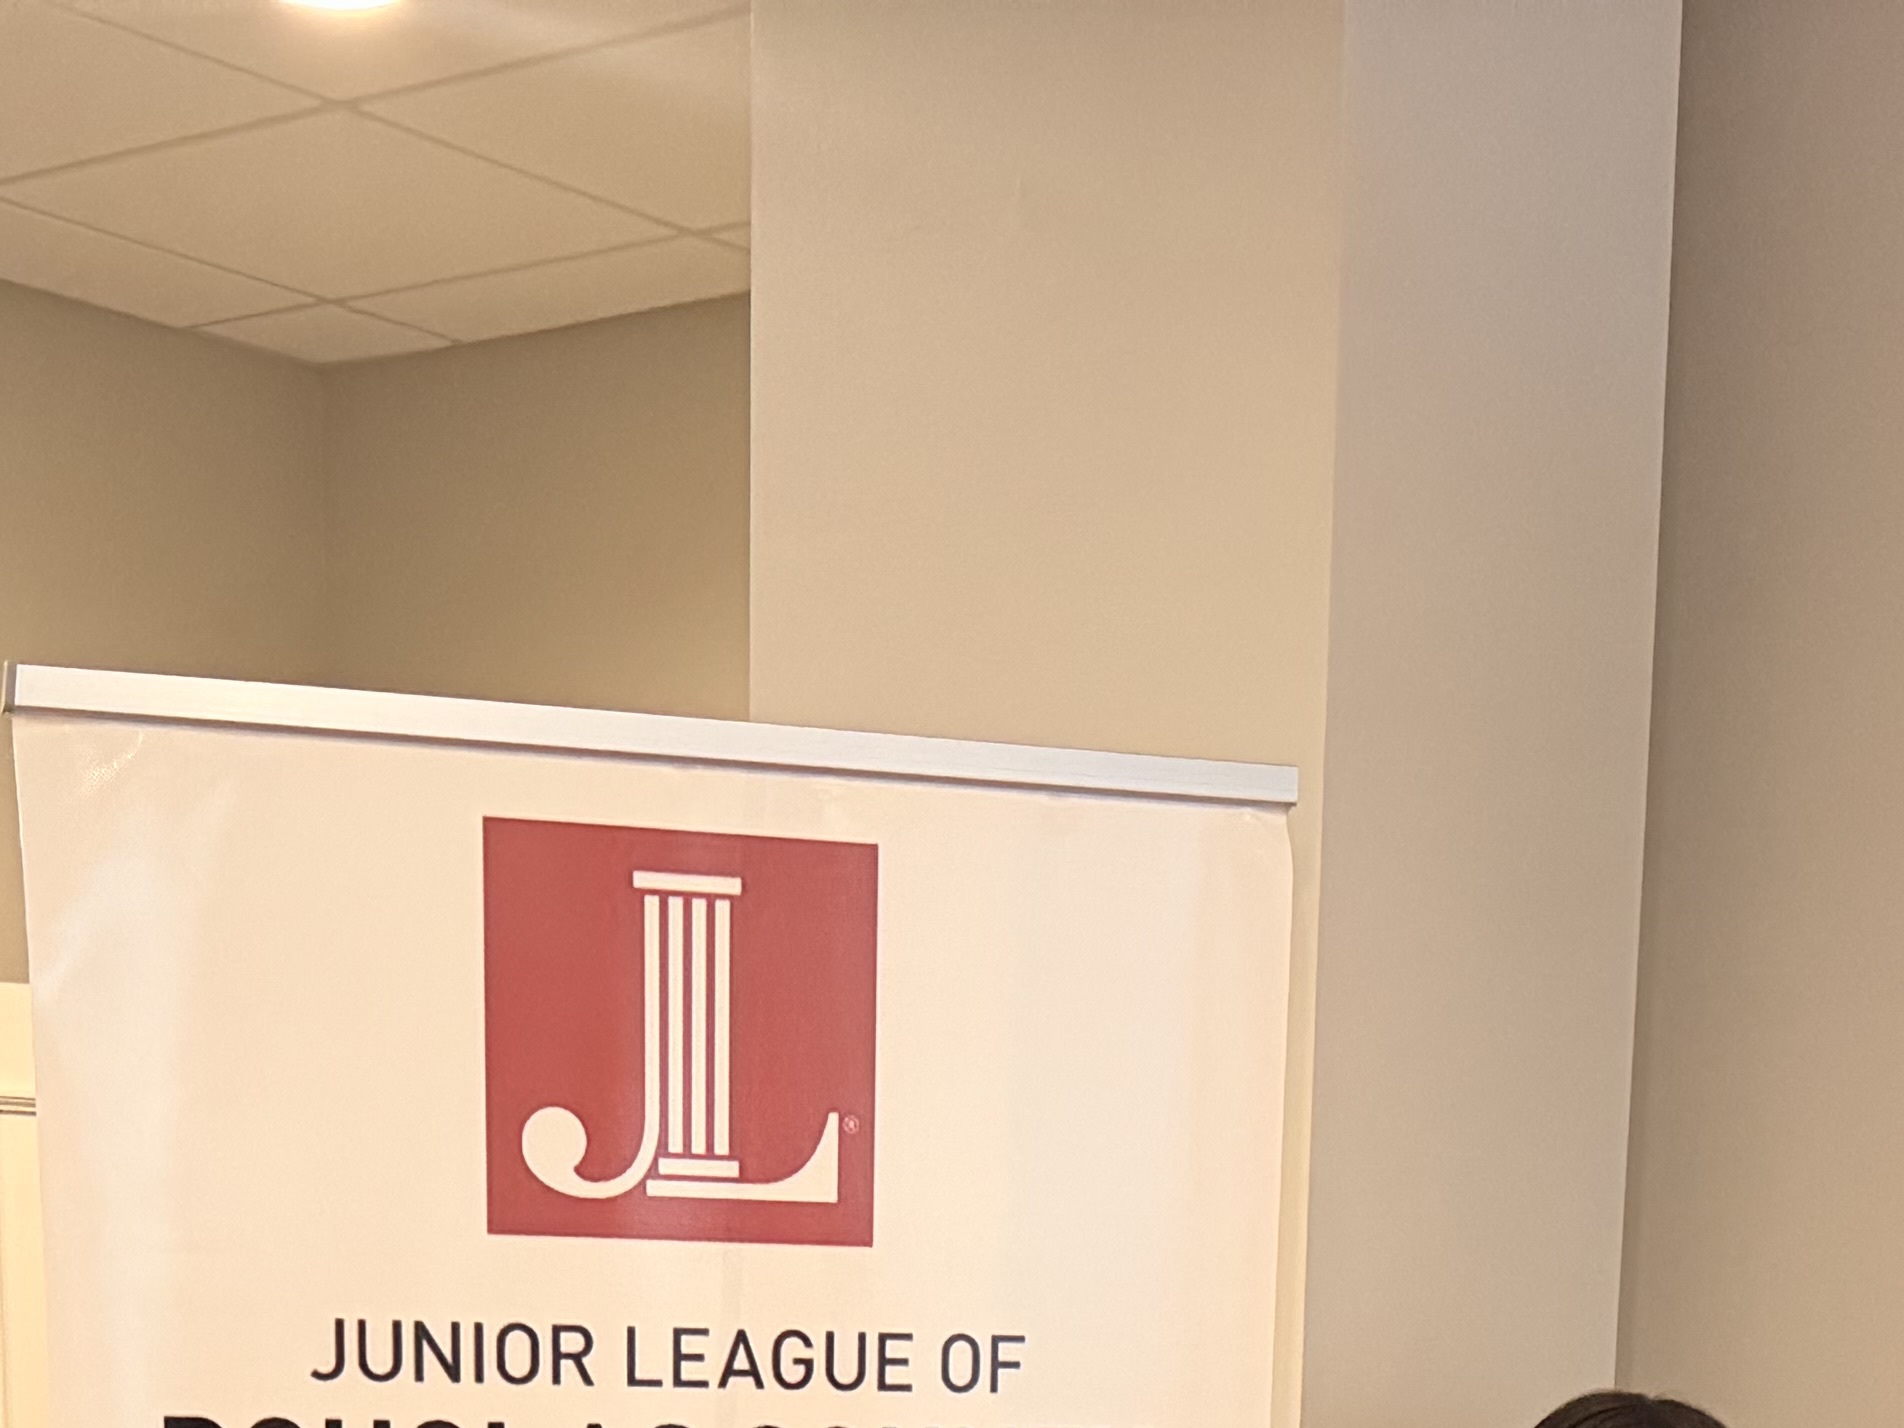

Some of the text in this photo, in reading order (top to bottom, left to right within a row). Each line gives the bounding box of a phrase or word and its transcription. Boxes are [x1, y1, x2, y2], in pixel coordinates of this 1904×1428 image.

[310, 1317, 1028, 1395] JUNIOR LEAGUE OF
